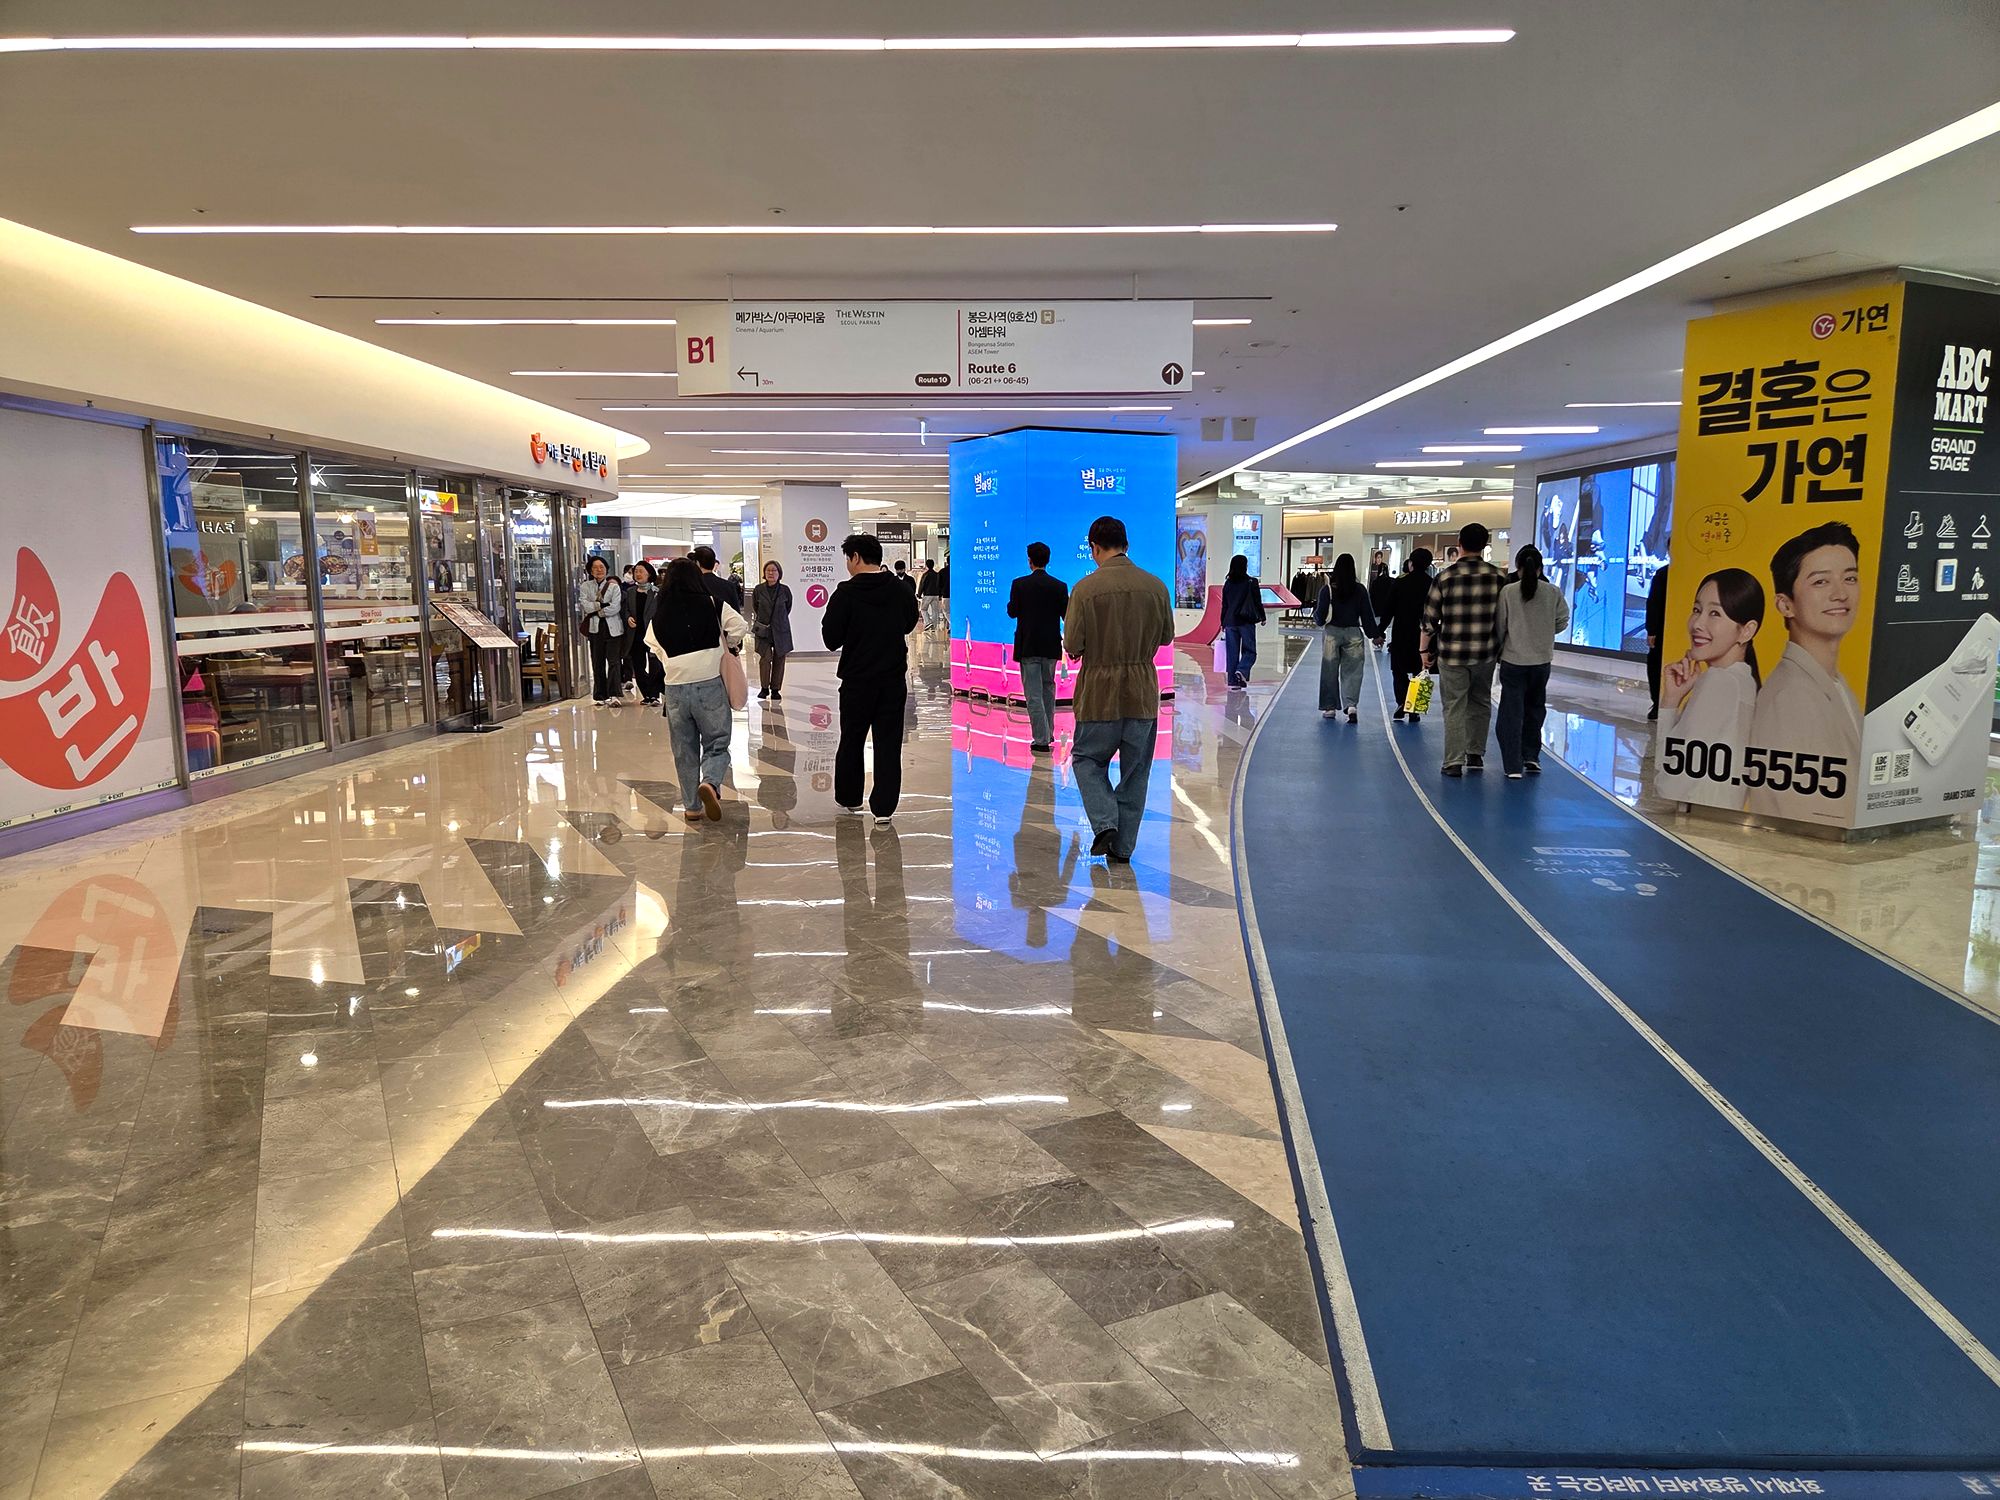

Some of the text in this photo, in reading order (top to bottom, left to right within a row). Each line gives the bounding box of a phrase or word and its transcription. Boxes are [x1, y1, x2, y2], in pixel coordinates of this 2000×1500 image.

[735, 311, 826, 324] 메가박스/아쿠아리움
[836, 309, 885, 318] THE WESTIN
[967, 310, 1038, 324] 봉은사역(9호선)
[1840, 303, 1889, 334] 가연
[968, 326, 1006, 338] 아셈타워
[687, 335, 715, 364] B1
[968, 363, 1017, 374] Route 6
[1936, 345, 1992, 392] ABC
[918, 376, 948, 384] Route 10
[968, 376, 1029, 385] (06-21 06-45)
[1698, 359, 1872, 436] 결혼은
[1933, 391, 1988, 424] MART
[1930, 437, 1976, 455] GRAND
[1741, 433, 1868, 504] 가연
[1929, 455, 1971, 472] STAGE
[1081, 468, 1126, 494] 별마당길
[1393, 509, 1451, 525] FAHREN
[1704, 511, 1729, 527] 지금은
[1723, 528, 1731, 544] 중
[797, 545, 836, 553] 9호선 봉은사역
[805, 565, 834, 573] 아셈플라자
[360, 609, 382, 618] Slow Food
[7, 595, 55, 665] 飯
[38, 640, 138, 782] 반
[1662, 736, 1848, 799] 500.5555
[161, 780, 173, 788] EXIT
[112, 792, 124, 800] EXIT
[1943, 788, 1976, 801] GRAND STAGE
[59, 805, 72, 813] EXIT
[1526, 1475, 1825, 1494] 화재시 방화셔터 내려오는 곳
